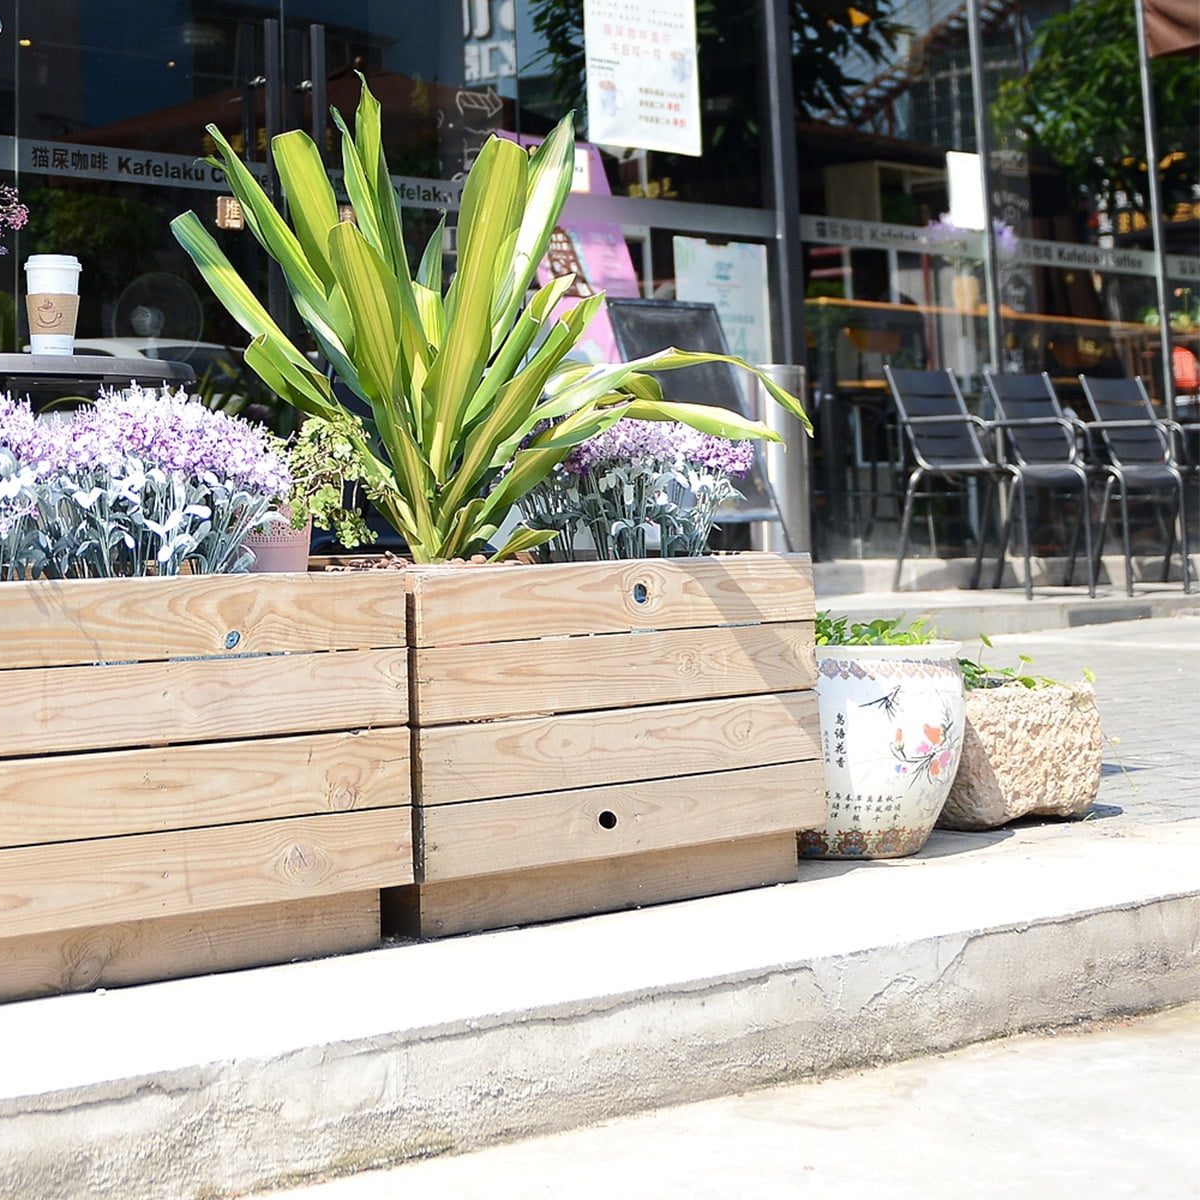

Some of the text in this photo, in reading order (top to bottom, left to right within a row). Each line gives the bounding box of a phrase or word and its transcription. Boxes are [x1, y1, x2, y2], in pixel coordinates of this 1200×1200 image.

[31, 146, 108, 174] 猫屎咖啡
[118, 156, 205, 183] Kafelaku
